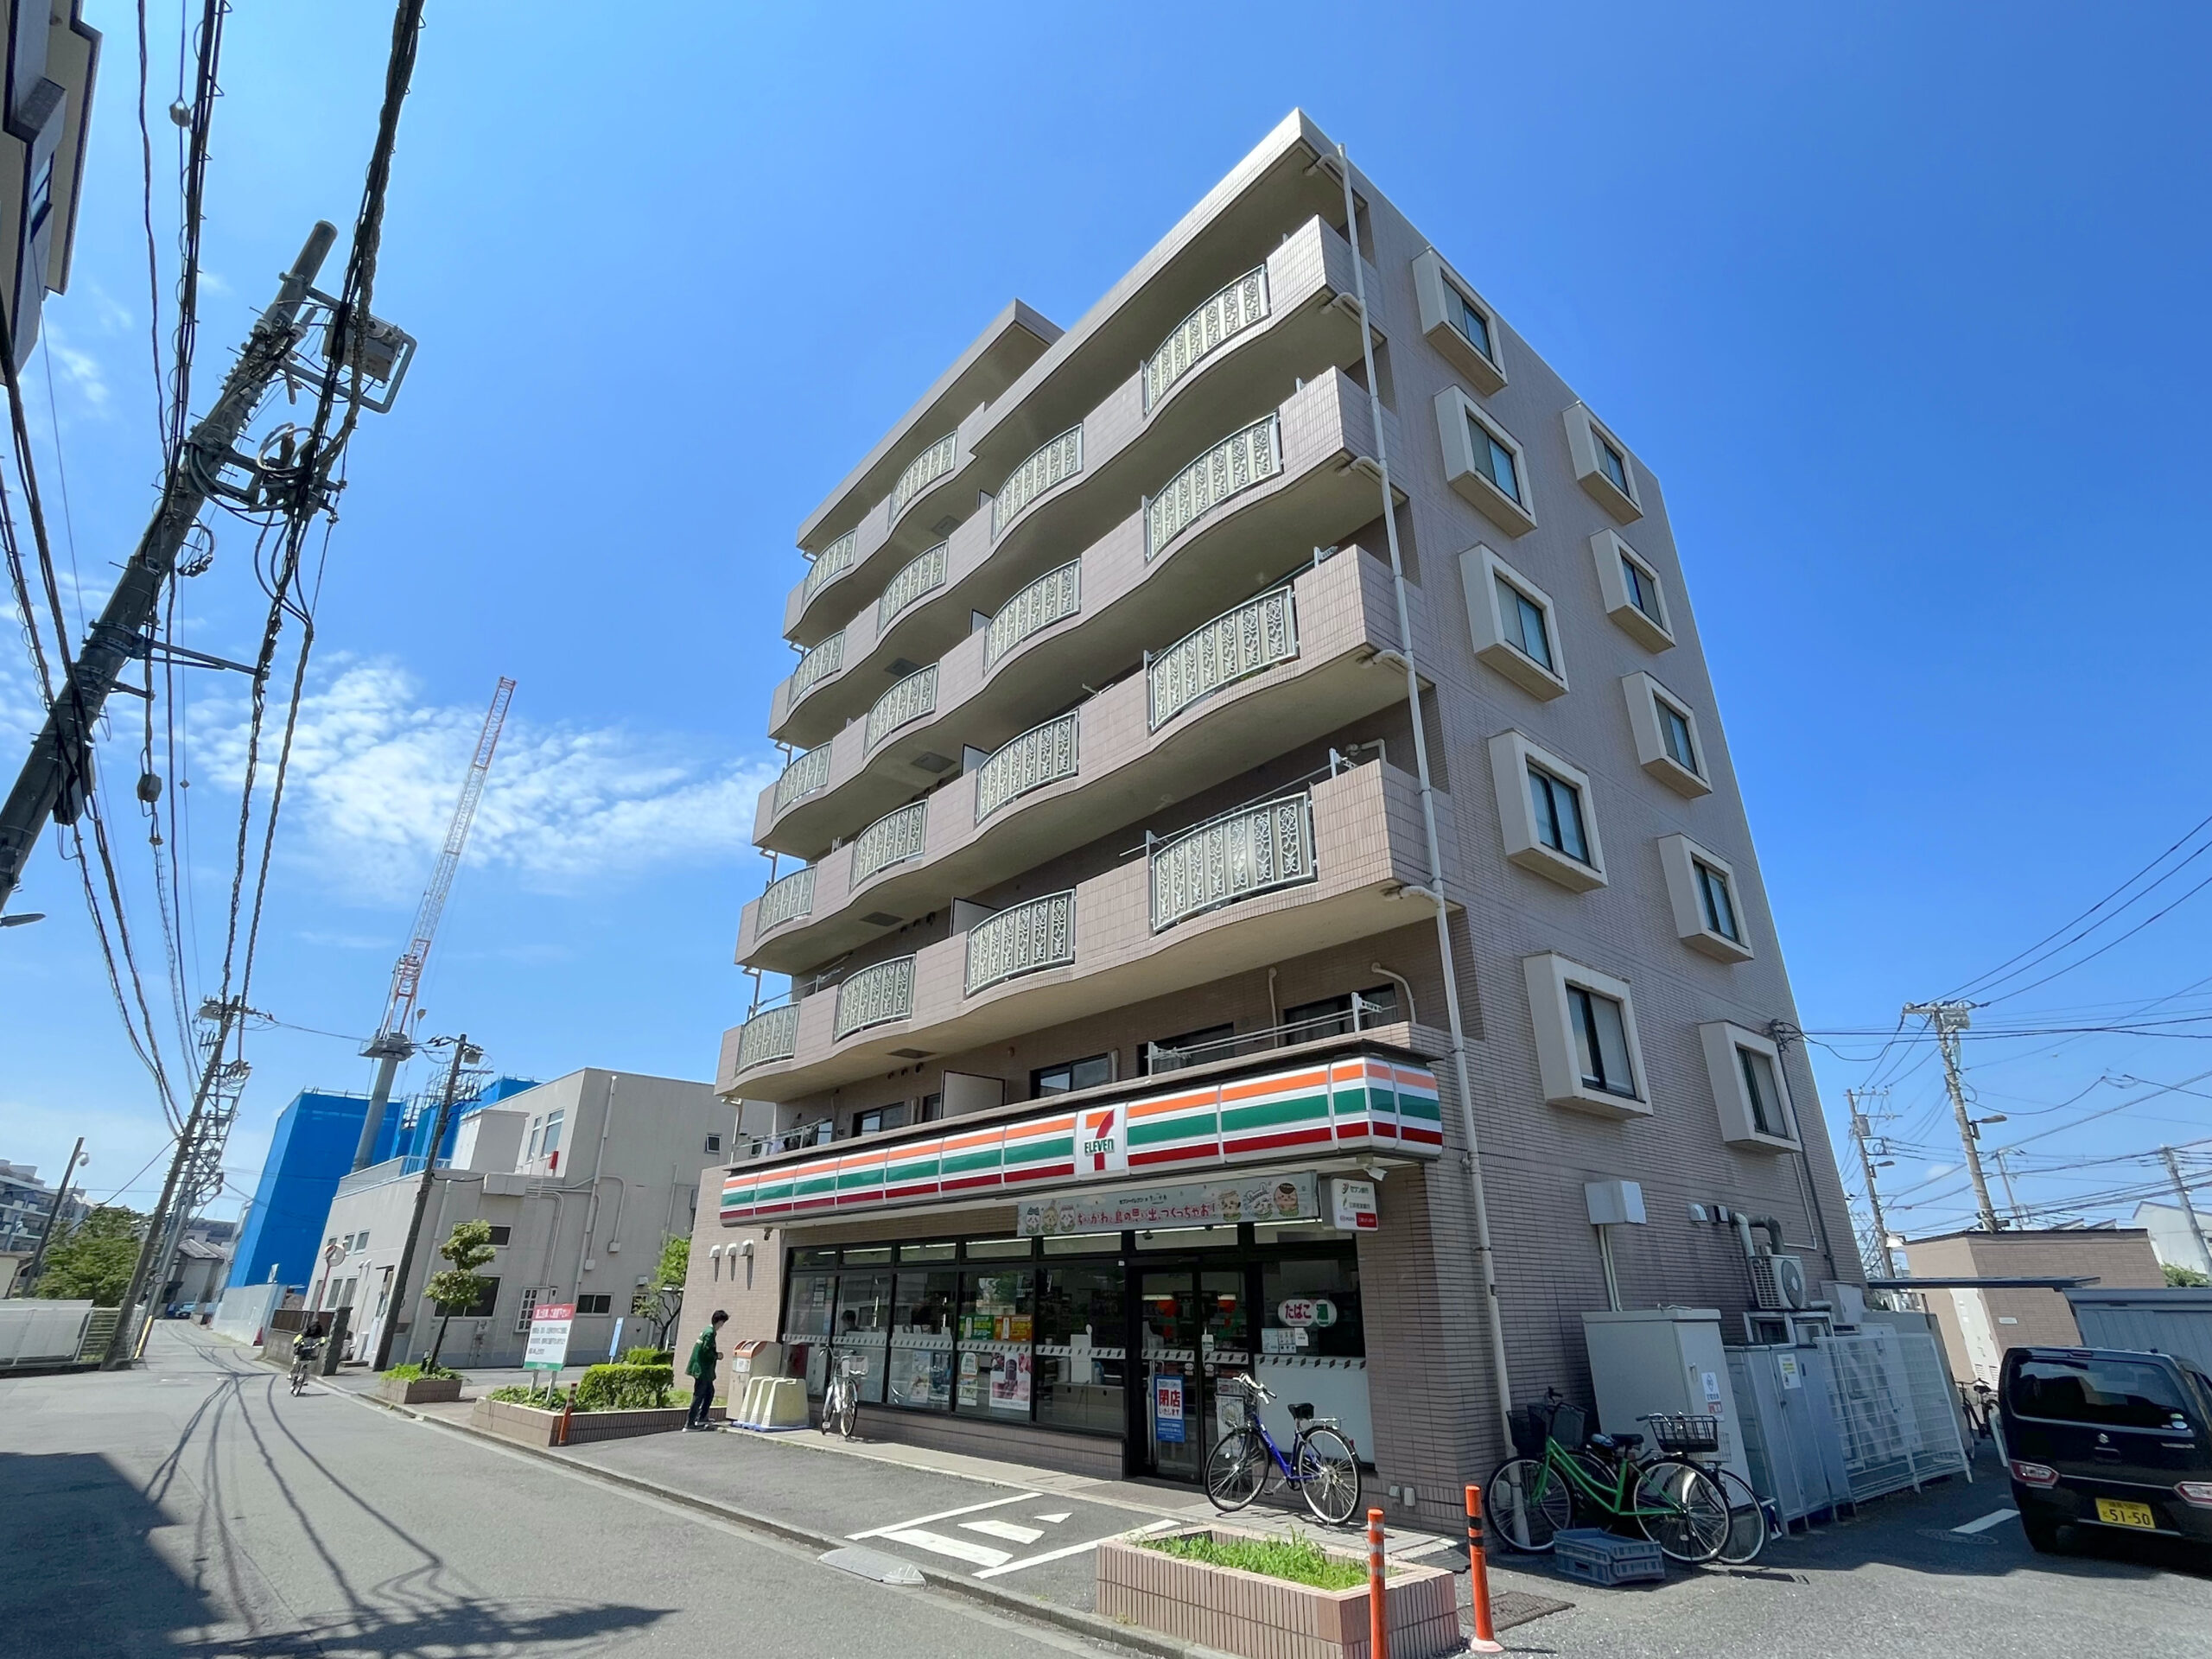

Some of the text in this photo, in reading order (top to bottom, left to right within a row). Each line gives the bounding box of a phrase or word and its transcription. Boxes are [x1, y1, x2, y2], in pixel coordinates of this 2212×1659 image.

[1285, 1303, 1312, 1319] たばこ
[1158, 1389, 1181, 1408] 閉店
